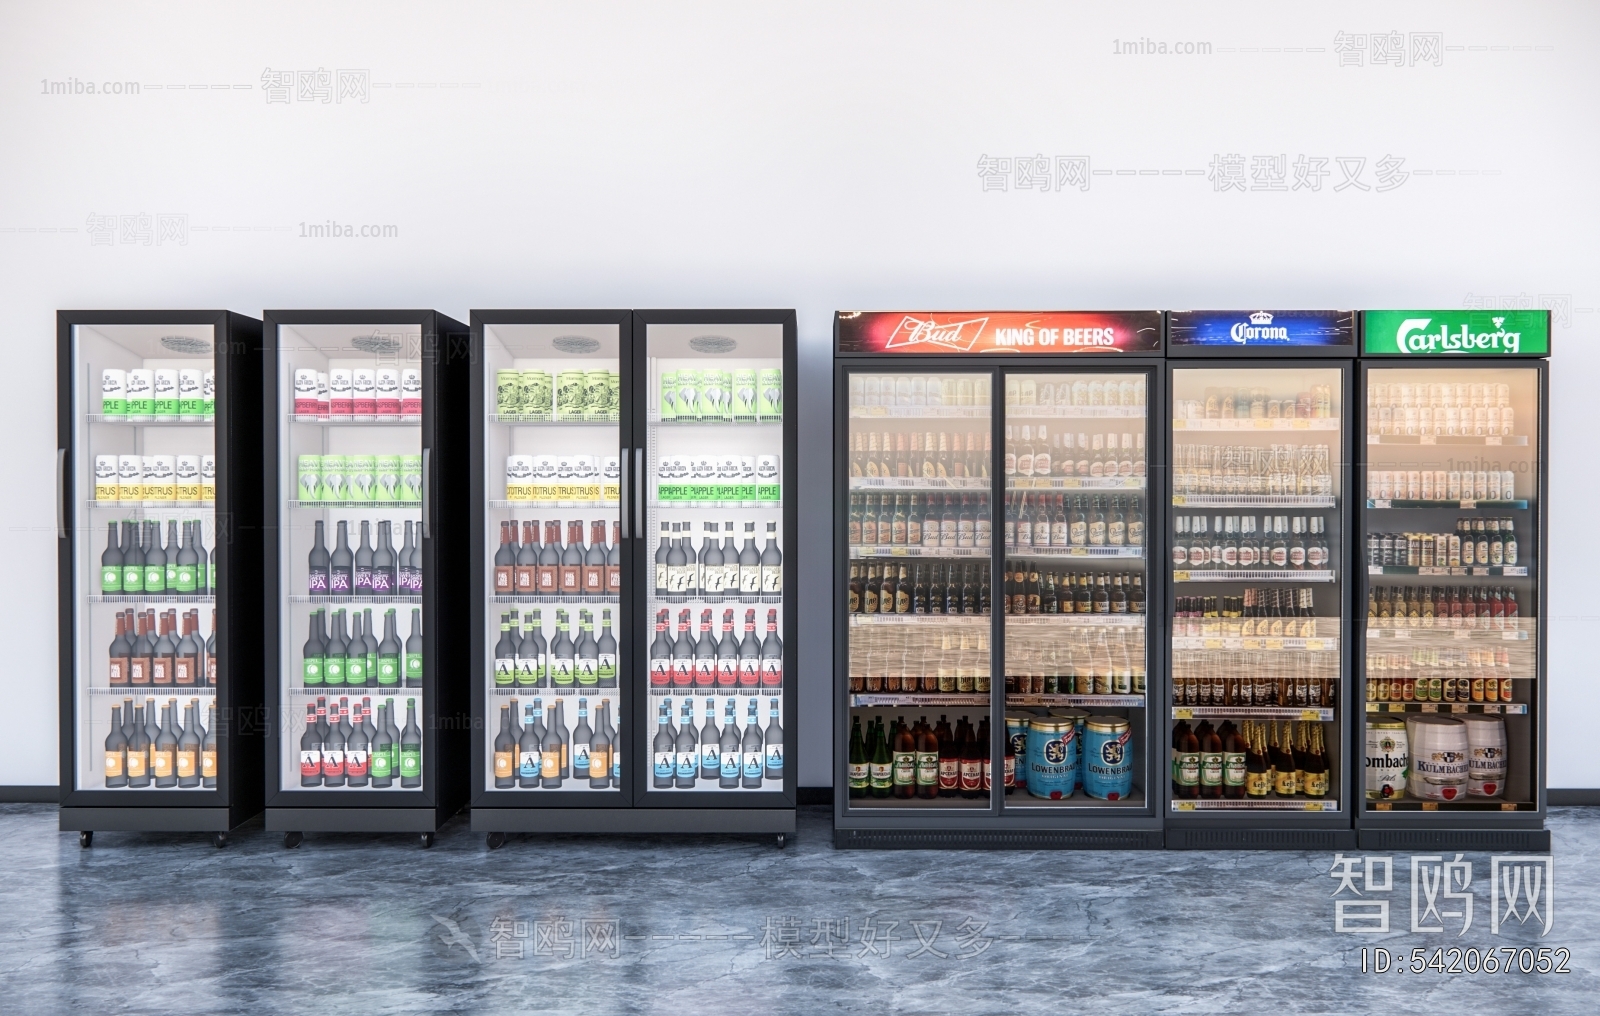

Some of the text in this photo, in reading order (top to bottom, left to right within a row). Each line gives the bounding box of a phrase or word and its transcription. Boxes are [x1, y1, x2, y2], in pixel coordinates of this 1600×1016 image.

[904, 320, 963, 343] Bud
[1230, 321, 1288, 344] Corona
[995, 327, 1114, 346] KING OF BEERS
[1396, 318, 1521, 354] Carlsberg
[103, 401, 118, 409] PPLE
[131, 401, 147, 409] PPLE
[156, 401, 172, 409] PPLE
[180, 401, 196, 409] PPLE
[97, 487, 116, 495] TRUS
[120, 487, 139, 495] TRUS
[154, 487, 173, 495] TRUS
[177, 487, 198, 495] TRUS
[203, 487, 215, 495] TRU
[742, 487, 753, 495] PLE
[310, 580, 326, 588] IPA
[332, 580, 348, 588] IPA
[356, 577, 371, 585] IPA
[373, 580, 389, 588] IPA
[1366, 754, 1408, 768] ombach
